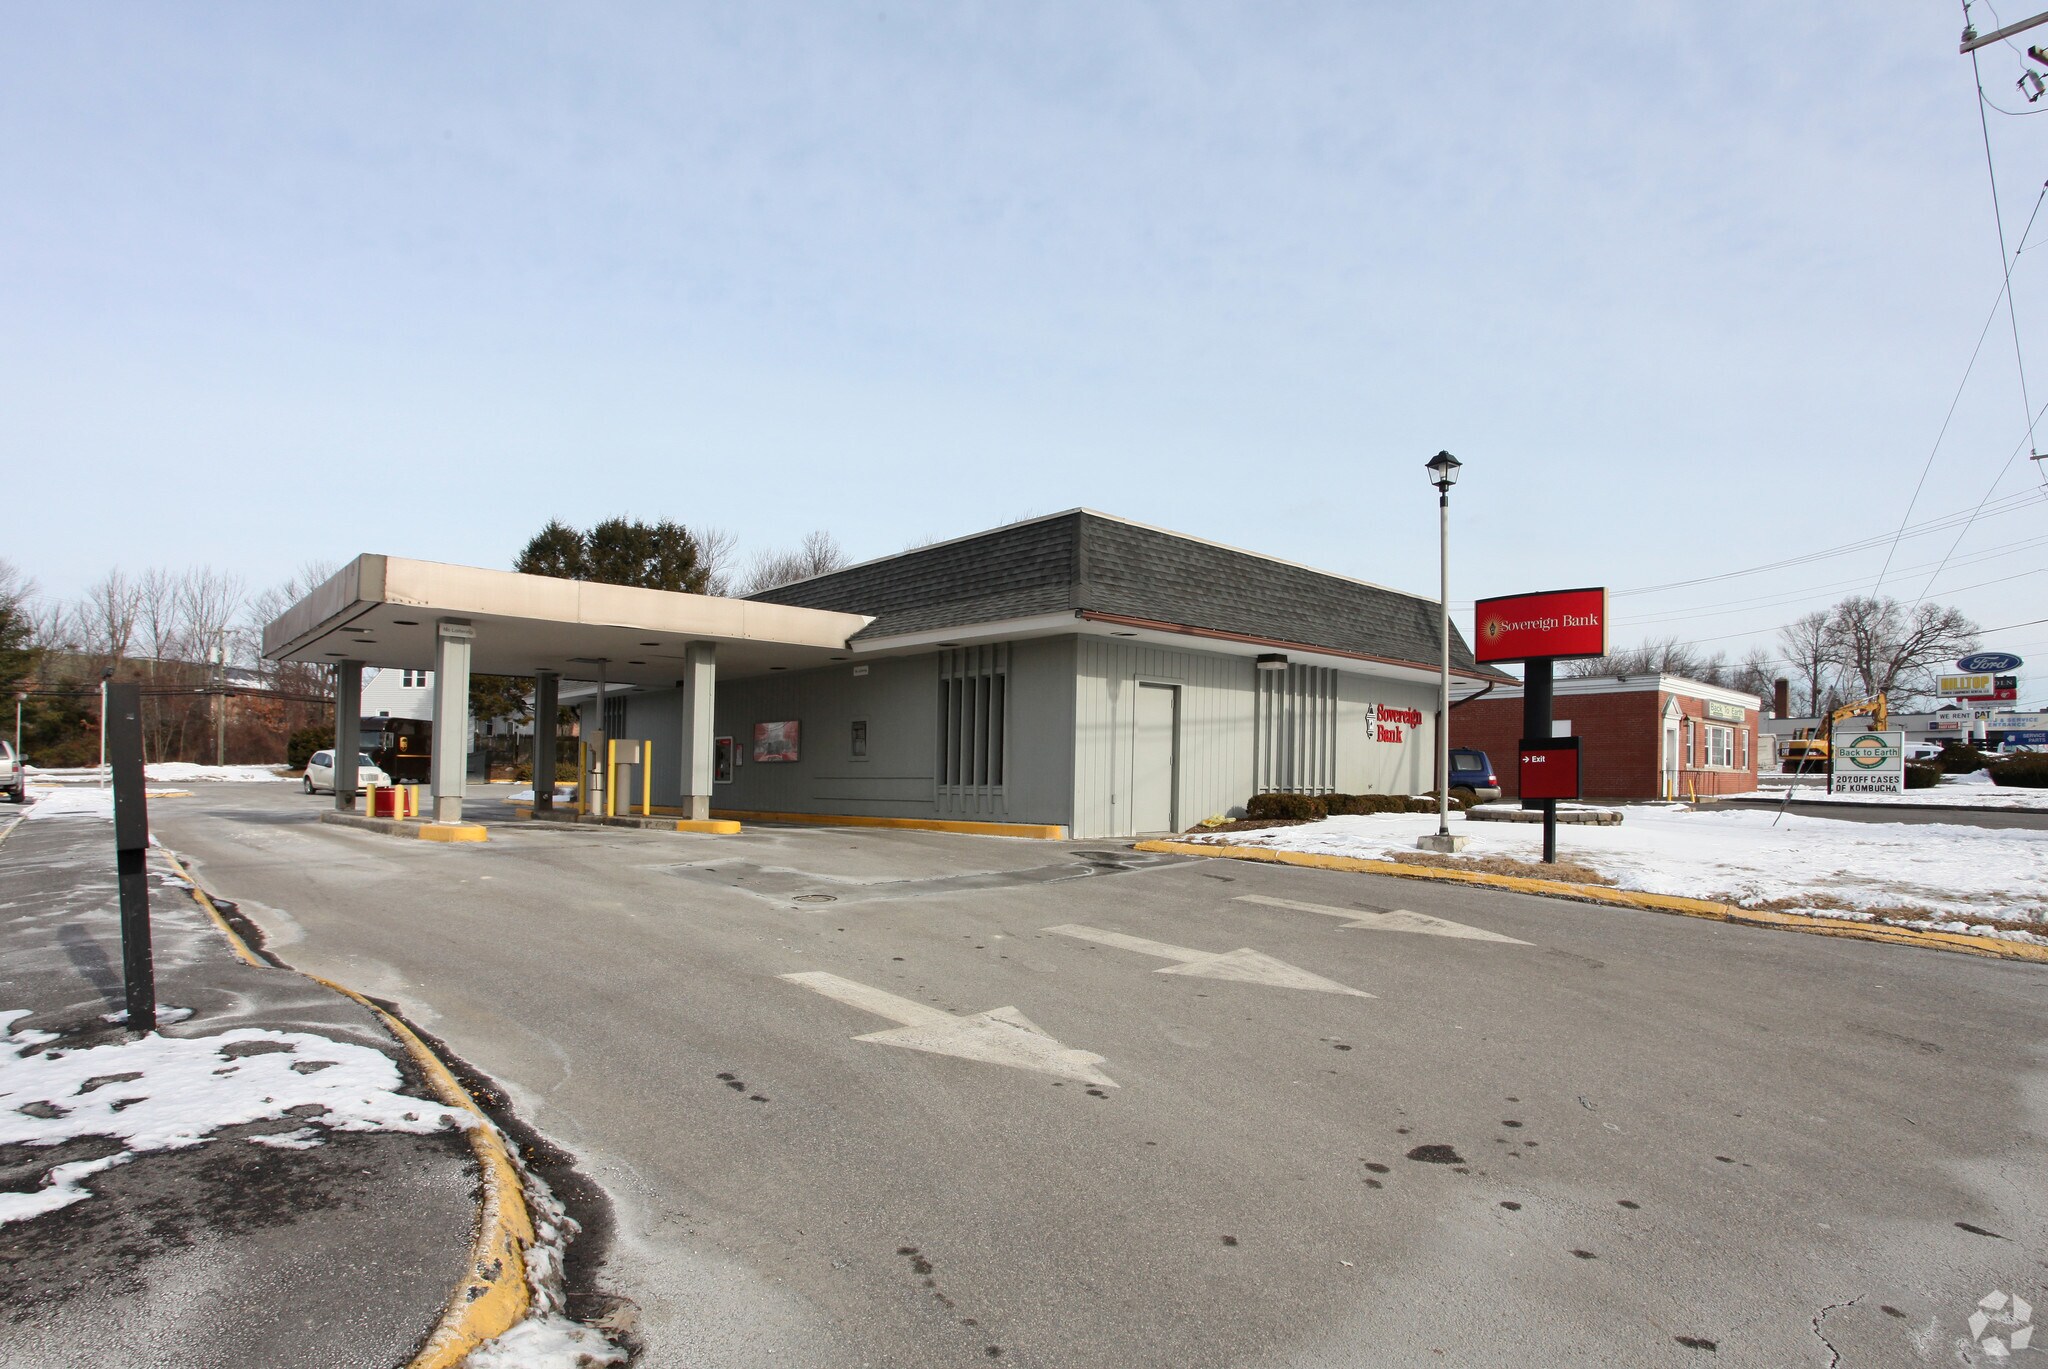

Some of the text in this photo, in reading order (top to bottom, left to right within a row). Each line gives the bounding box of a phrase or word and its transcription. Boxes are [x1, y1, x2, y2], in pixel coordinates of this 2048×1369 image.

[1501, 613, 1599, 632] Sovereign Bank
[1970, 656, 2008, 670] Ford
[1941, 675, 1990, 690] HILLTOP
[1377, 703, 1422, 729] Sovereign
[1710, 702, 1722, 712] Back
[1732, 707, 1743, 716] Earth
[1974, 710, 1991, 719] CAT
[1377, 724, 1402, 743] Bank
[1531, 755, 1546, 763] Exit
[1839, 748, 1898, 756] Back to Earth
[1870, 775, 1900, 783] CASES
[1836, 784, 1897, 792] OF KOMBUCHA
